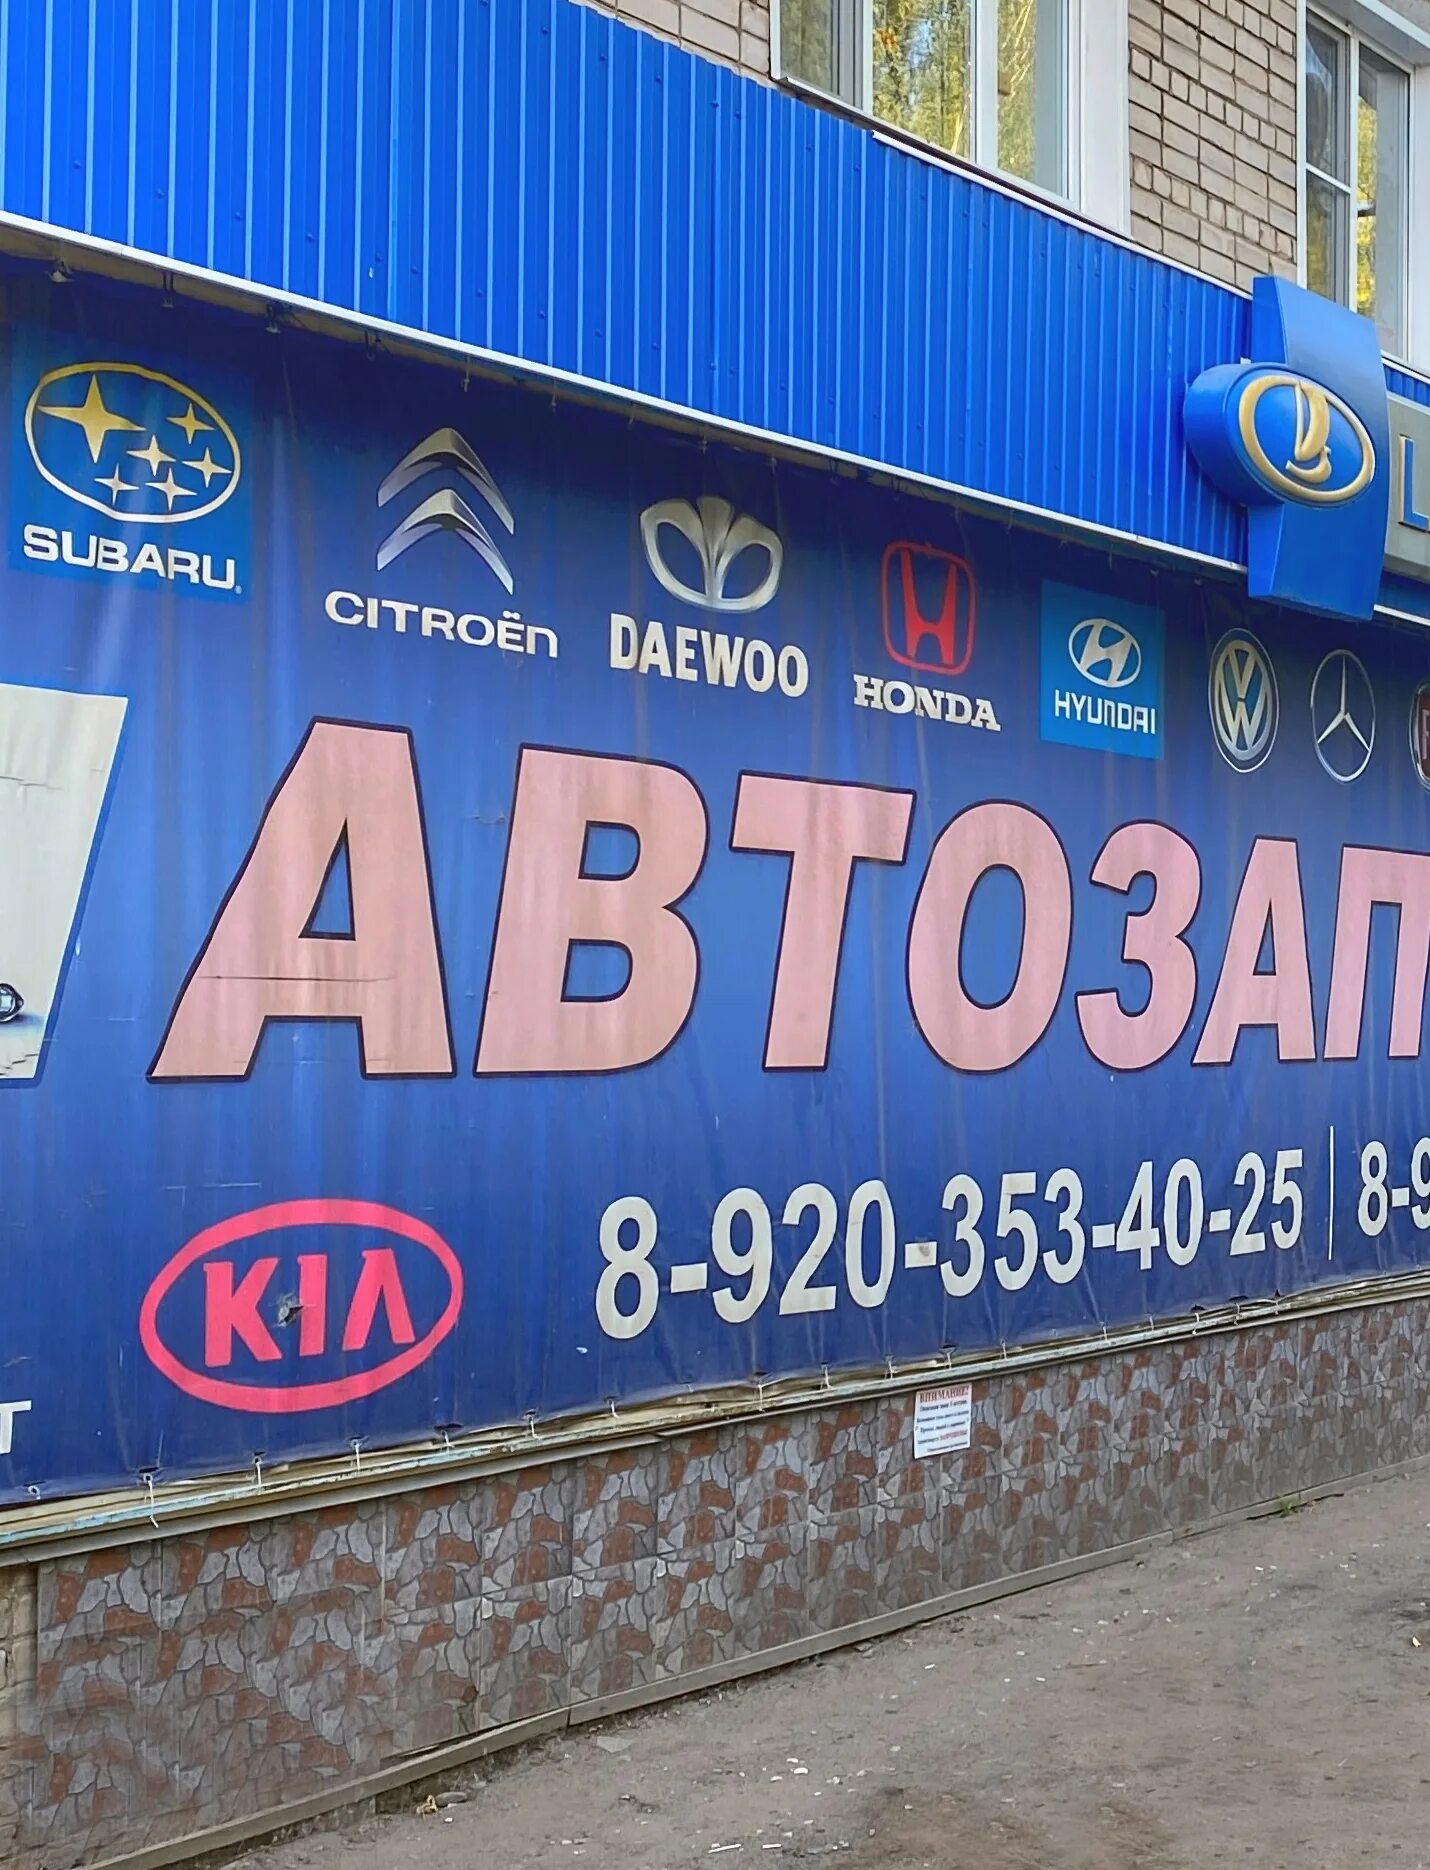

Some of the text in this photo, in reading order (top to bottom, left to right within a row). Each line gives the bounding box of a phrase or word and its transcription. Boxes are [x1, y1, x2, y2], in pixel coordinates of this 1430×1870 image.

[23, 524, 238, 591] SUBARU
[610, 613, 808, 697] DAEWOO
[853, 674, 1000, 732] HONDA
[1053, 690, 1156, 735] HYUNDAI
[595, 1148, 1304, 1339] 8-920-353-40-25
[203, 1248, 415, 1367] KIA
